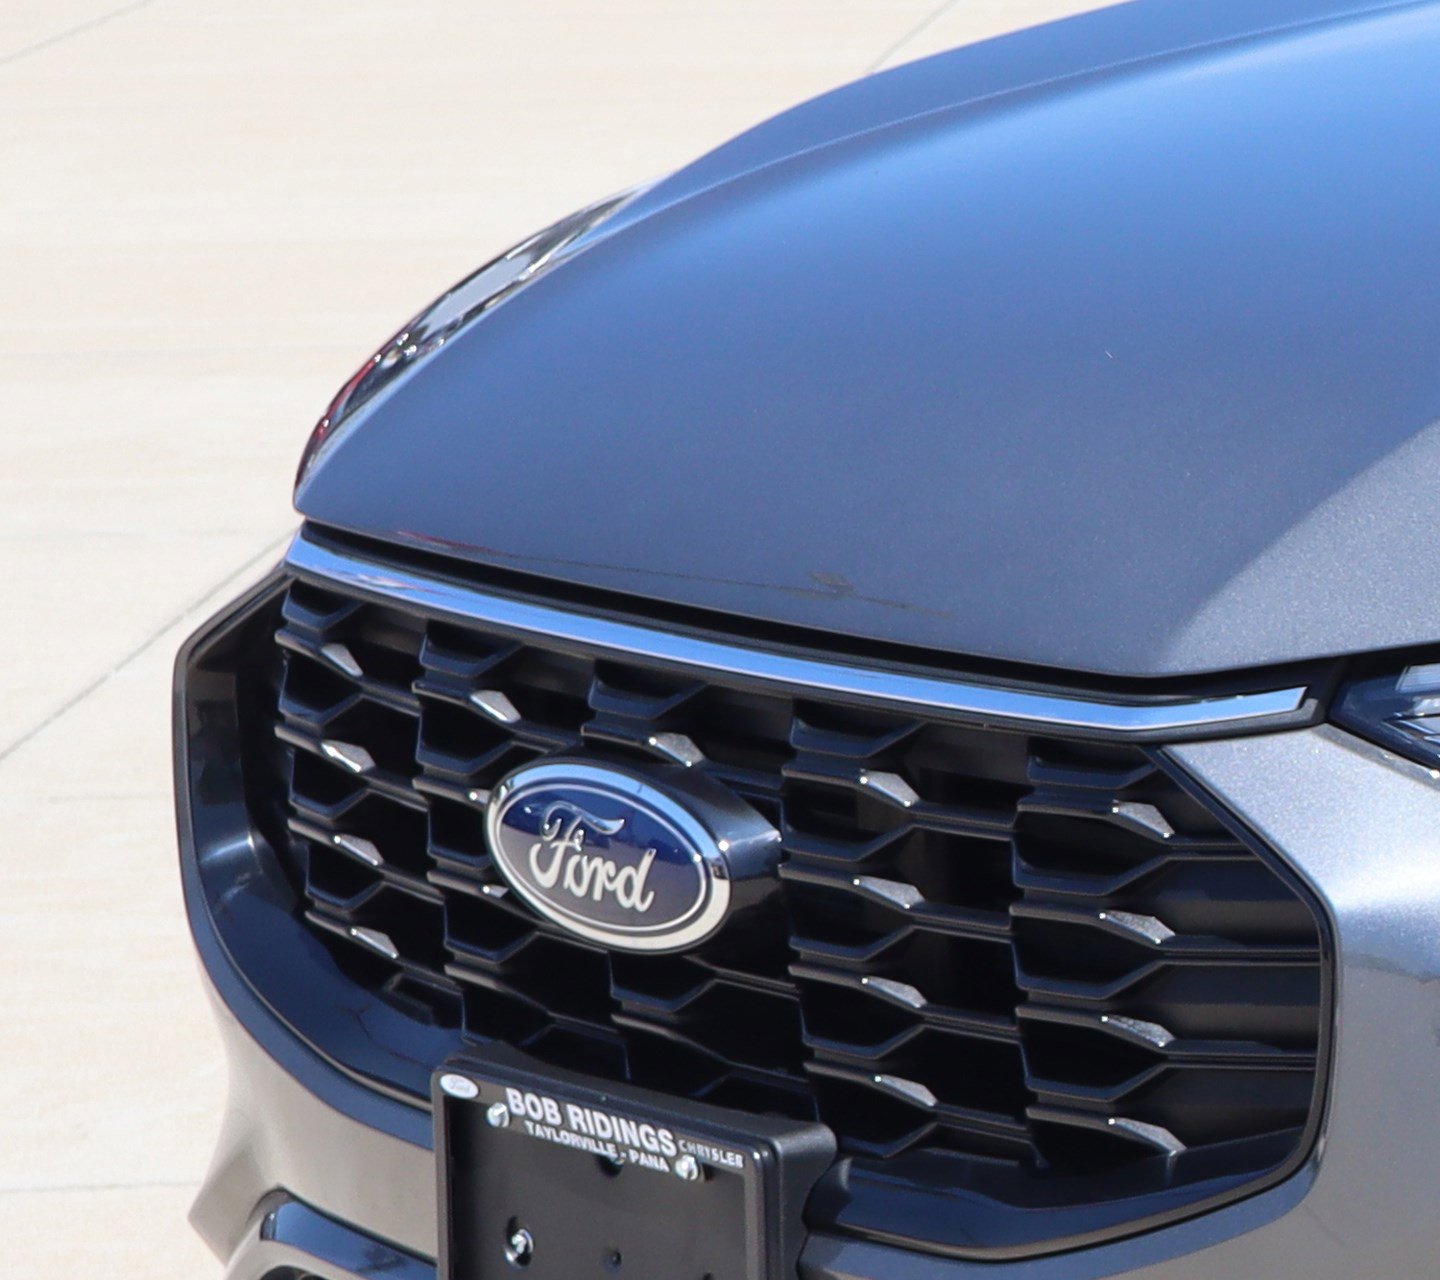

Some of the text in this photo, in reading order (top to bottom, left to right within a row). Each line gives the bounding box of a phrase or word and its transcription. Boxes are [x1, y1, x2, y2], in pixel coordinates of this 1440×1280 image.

[528, 800, 713, 912] Ford
[504, 1087, 678, 1158] BOB RIDINGS
[524, 1120, 619, 1160] TAYLORVILLE
[629, 1148, 670, 1173] PANA
[679, 1138, 744, 1169] CHRYSLER
